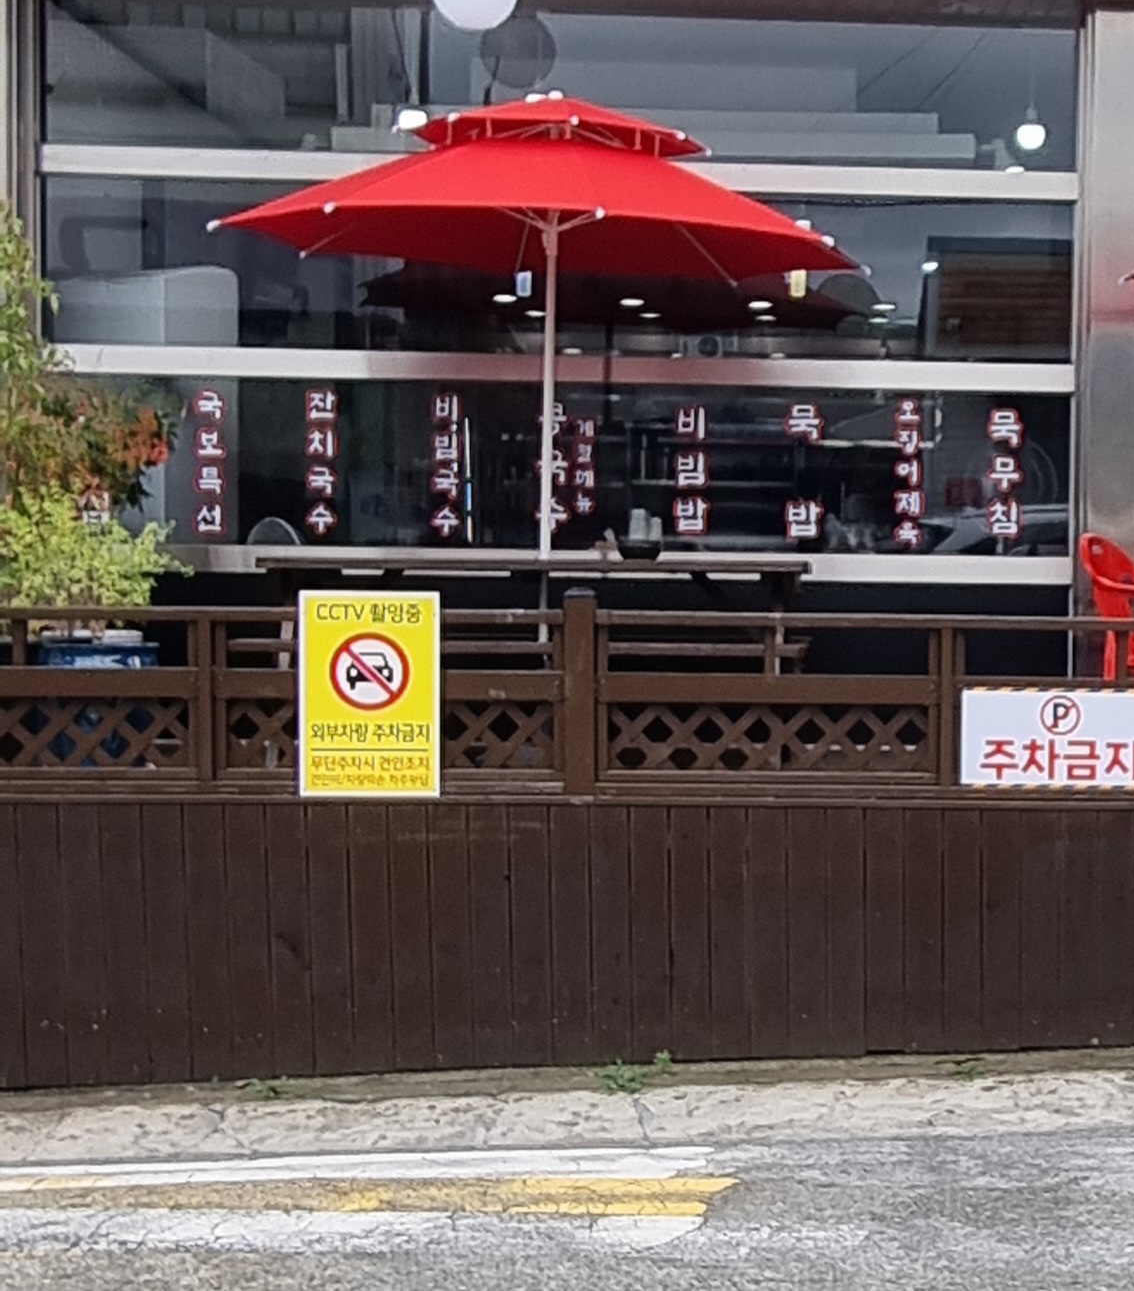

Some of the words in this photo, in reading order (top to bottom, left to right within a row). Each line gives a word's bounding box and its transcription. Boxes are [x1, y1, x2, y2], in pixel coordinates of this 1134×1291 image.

[195, 389, 226, 534] 국보특선
[307, 390, 338, 534] 잔치국수
[432, 394, 459, 537] 비빔국수
[676, 406, 710, 534] 비빔밥
[989, 408, 1024, 539] 묵무침
[316, 603, 365, 621] CCTV
[369, 603, 421, 625] 촬영중
[310, 723, 369, 743] 외부차량
[372, 723, 431, 743] 주차금지
[310, 755, 376, 772] 무단주차시
